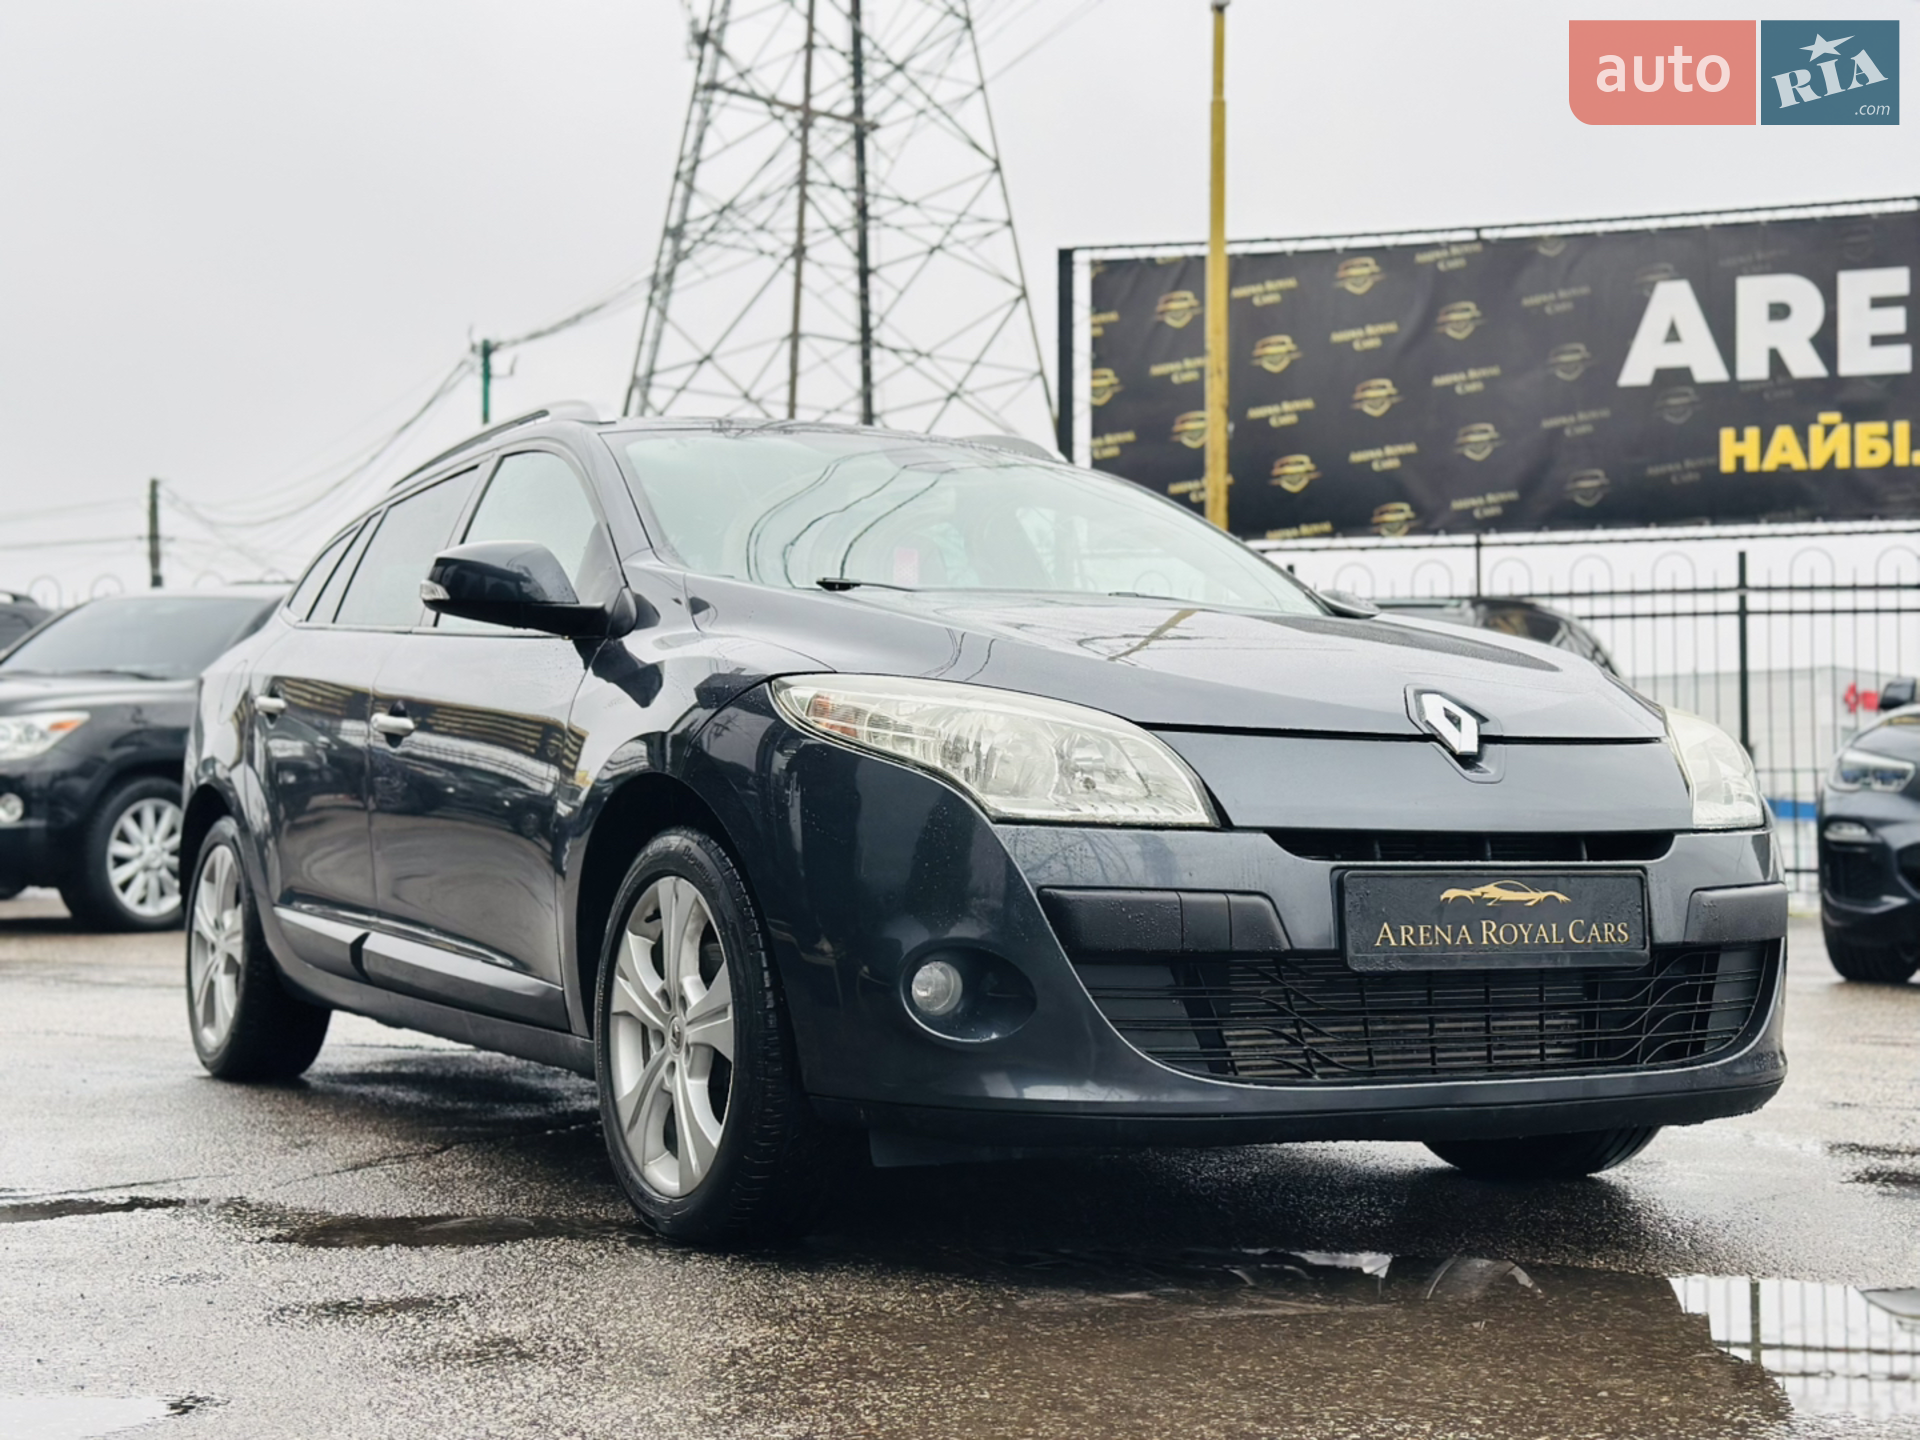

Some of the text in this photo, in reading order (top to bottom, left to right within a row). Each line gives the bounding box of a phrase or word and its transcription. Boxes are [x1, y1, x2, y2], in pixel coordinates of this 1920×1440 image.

[1617, 266, 1912, 388] ARE
[1720, 411, 1920, 473] НАЙБІ
[1375, 919, 1629, 947] ARENA ROYAL CARS
